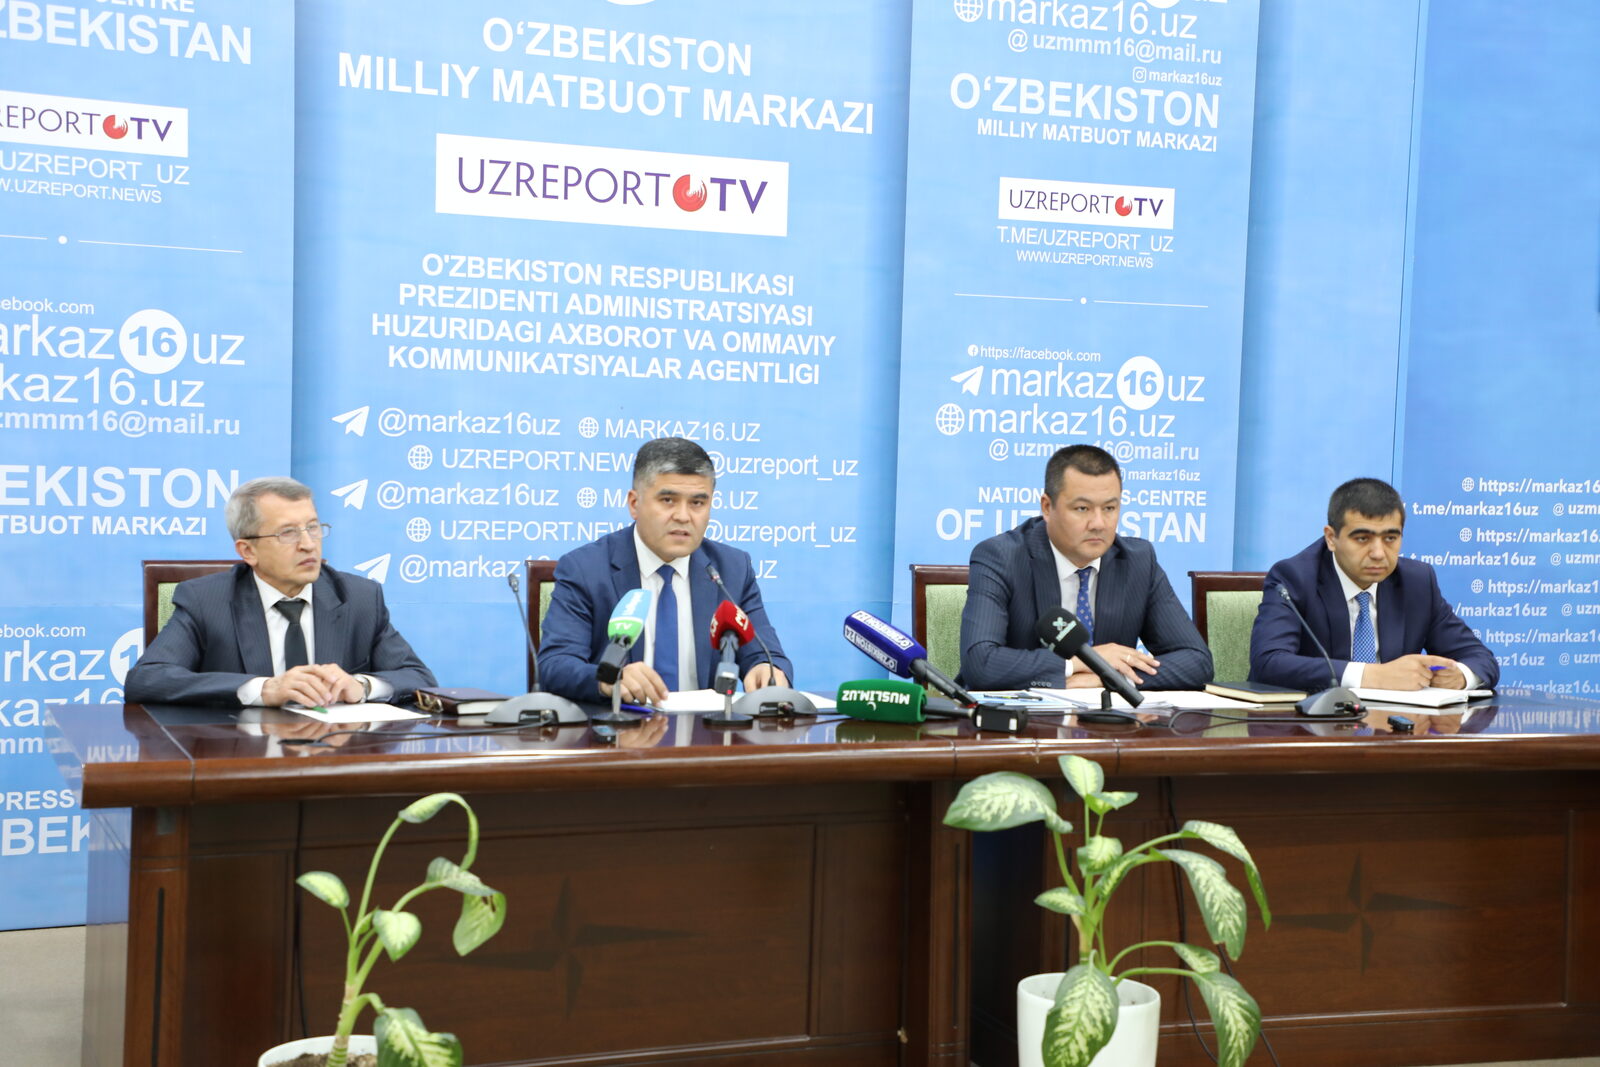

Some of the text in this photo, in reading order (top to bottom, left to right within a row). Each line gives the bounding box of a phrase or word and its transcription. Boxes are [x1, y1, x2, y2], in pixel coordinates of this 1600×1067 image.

[0, 0, 251, 64] BEKISTAN
[985, 0, 1198, 39] markaz16.uz
[1033, 34, 1223, 65] uzmmm16@mail.ru
[338, 52, 874, 135] MILLIY MATBUOT MARKAZI
[1148, 70, 1223, 87] markaz16uz
[0, 105, 173, 142] EPORT TV
[977, 118, 1217, 153] MILLIY MATBUOT MARKAZI
[457, 156, 769, 215] UZREPORT TV
[1009, 189, 1164, 217] UZREPORT TV
[996, 226, 1174, 256] T.ME/UZREPORT_UZ
[421, 253, 794, 297] O'ZBEKISTON RESPUBLIKASI
[1016, 250, 1154, 269] WWW.UZREPORT.NEWS
[399, 283, 813, 327] PREZIDENTI ADMINISTRATSIYASI
[128, 325, 178, 358] 16
[192, 332, 246, 366] uz
[372, 313, 836, 357] HUZURIDAGI AXBOROT VA OMMAVIY
[388, 345, 819, 385] KOMMUNIKATSIYALAR AGENTLIGI
[980, 345, 1101, 362] https://facebook.com
[991, 362, 1205, 402] markaz 16 uz
[0, 409, 240, 438] mmm16@mail.ru
[378, 407, 761, 442] @markaz16uz MARKAZ16.UZ
[968, 403, 1176, 438] markaz16.uz
[442, 448, 636, 473] UZREPORT.NEW
[1128, 469, 1201, 482] markaz16uz
[376, 480, 560, 510] @markaz16uz
[1412, 501, 1539, 516] t.me/markaz16uz
[1568, 503, 1600, 515] uzm
[92, 515, 207, 536] MARKAZI
[936, 508, 985, 542] OF
[842, 690, 910, 705] MUSLIM.UZ
